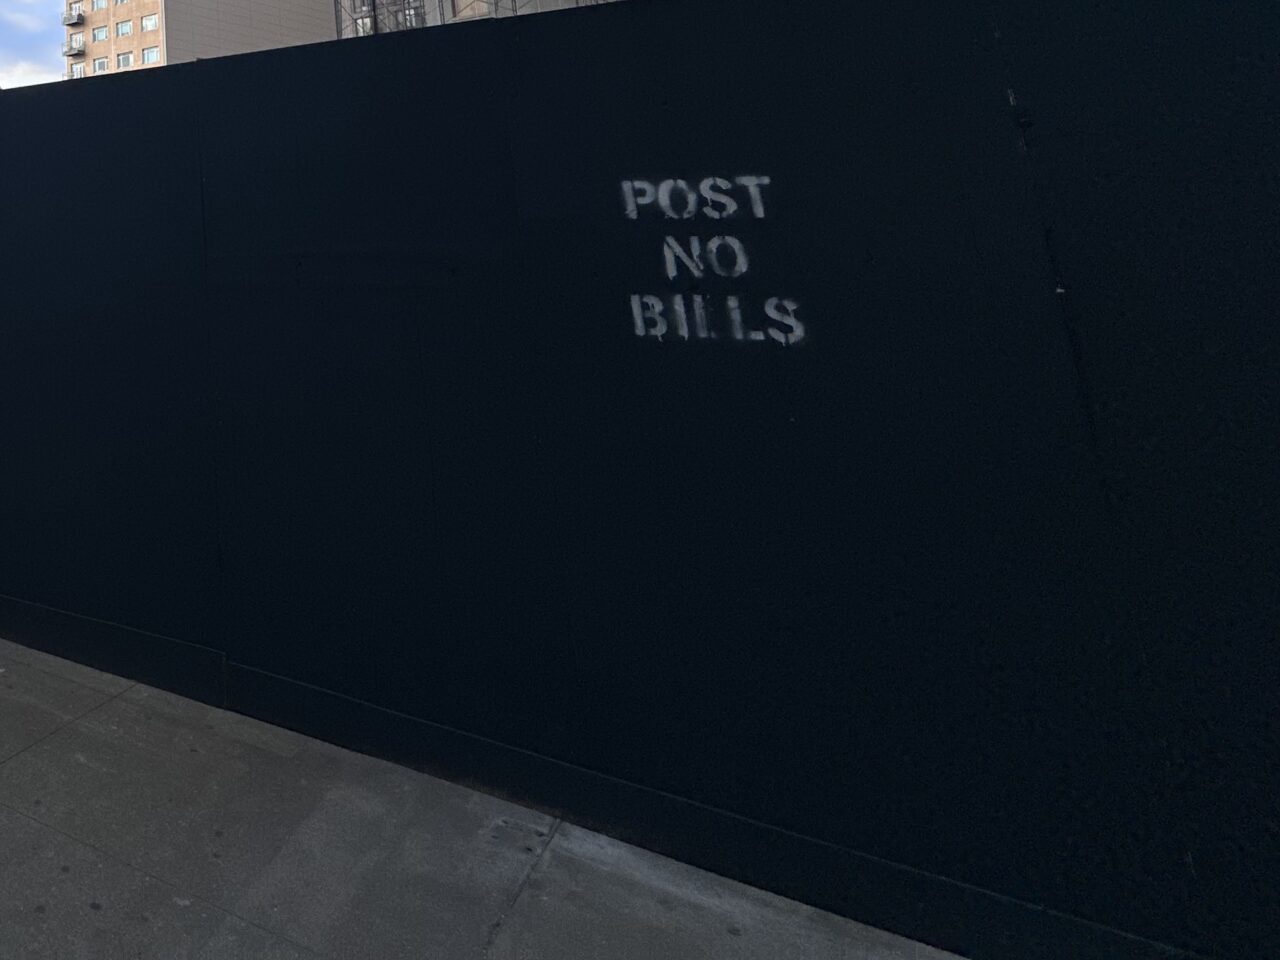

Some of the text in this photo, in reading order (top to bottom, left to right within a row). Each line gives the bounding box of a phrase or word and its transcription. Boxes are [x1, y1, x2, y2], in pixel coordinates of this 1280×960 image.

[621, 176, 770, 220] POST
[663, 235, 749, 280] NO
[630, 294, 806, 346] BILLS
